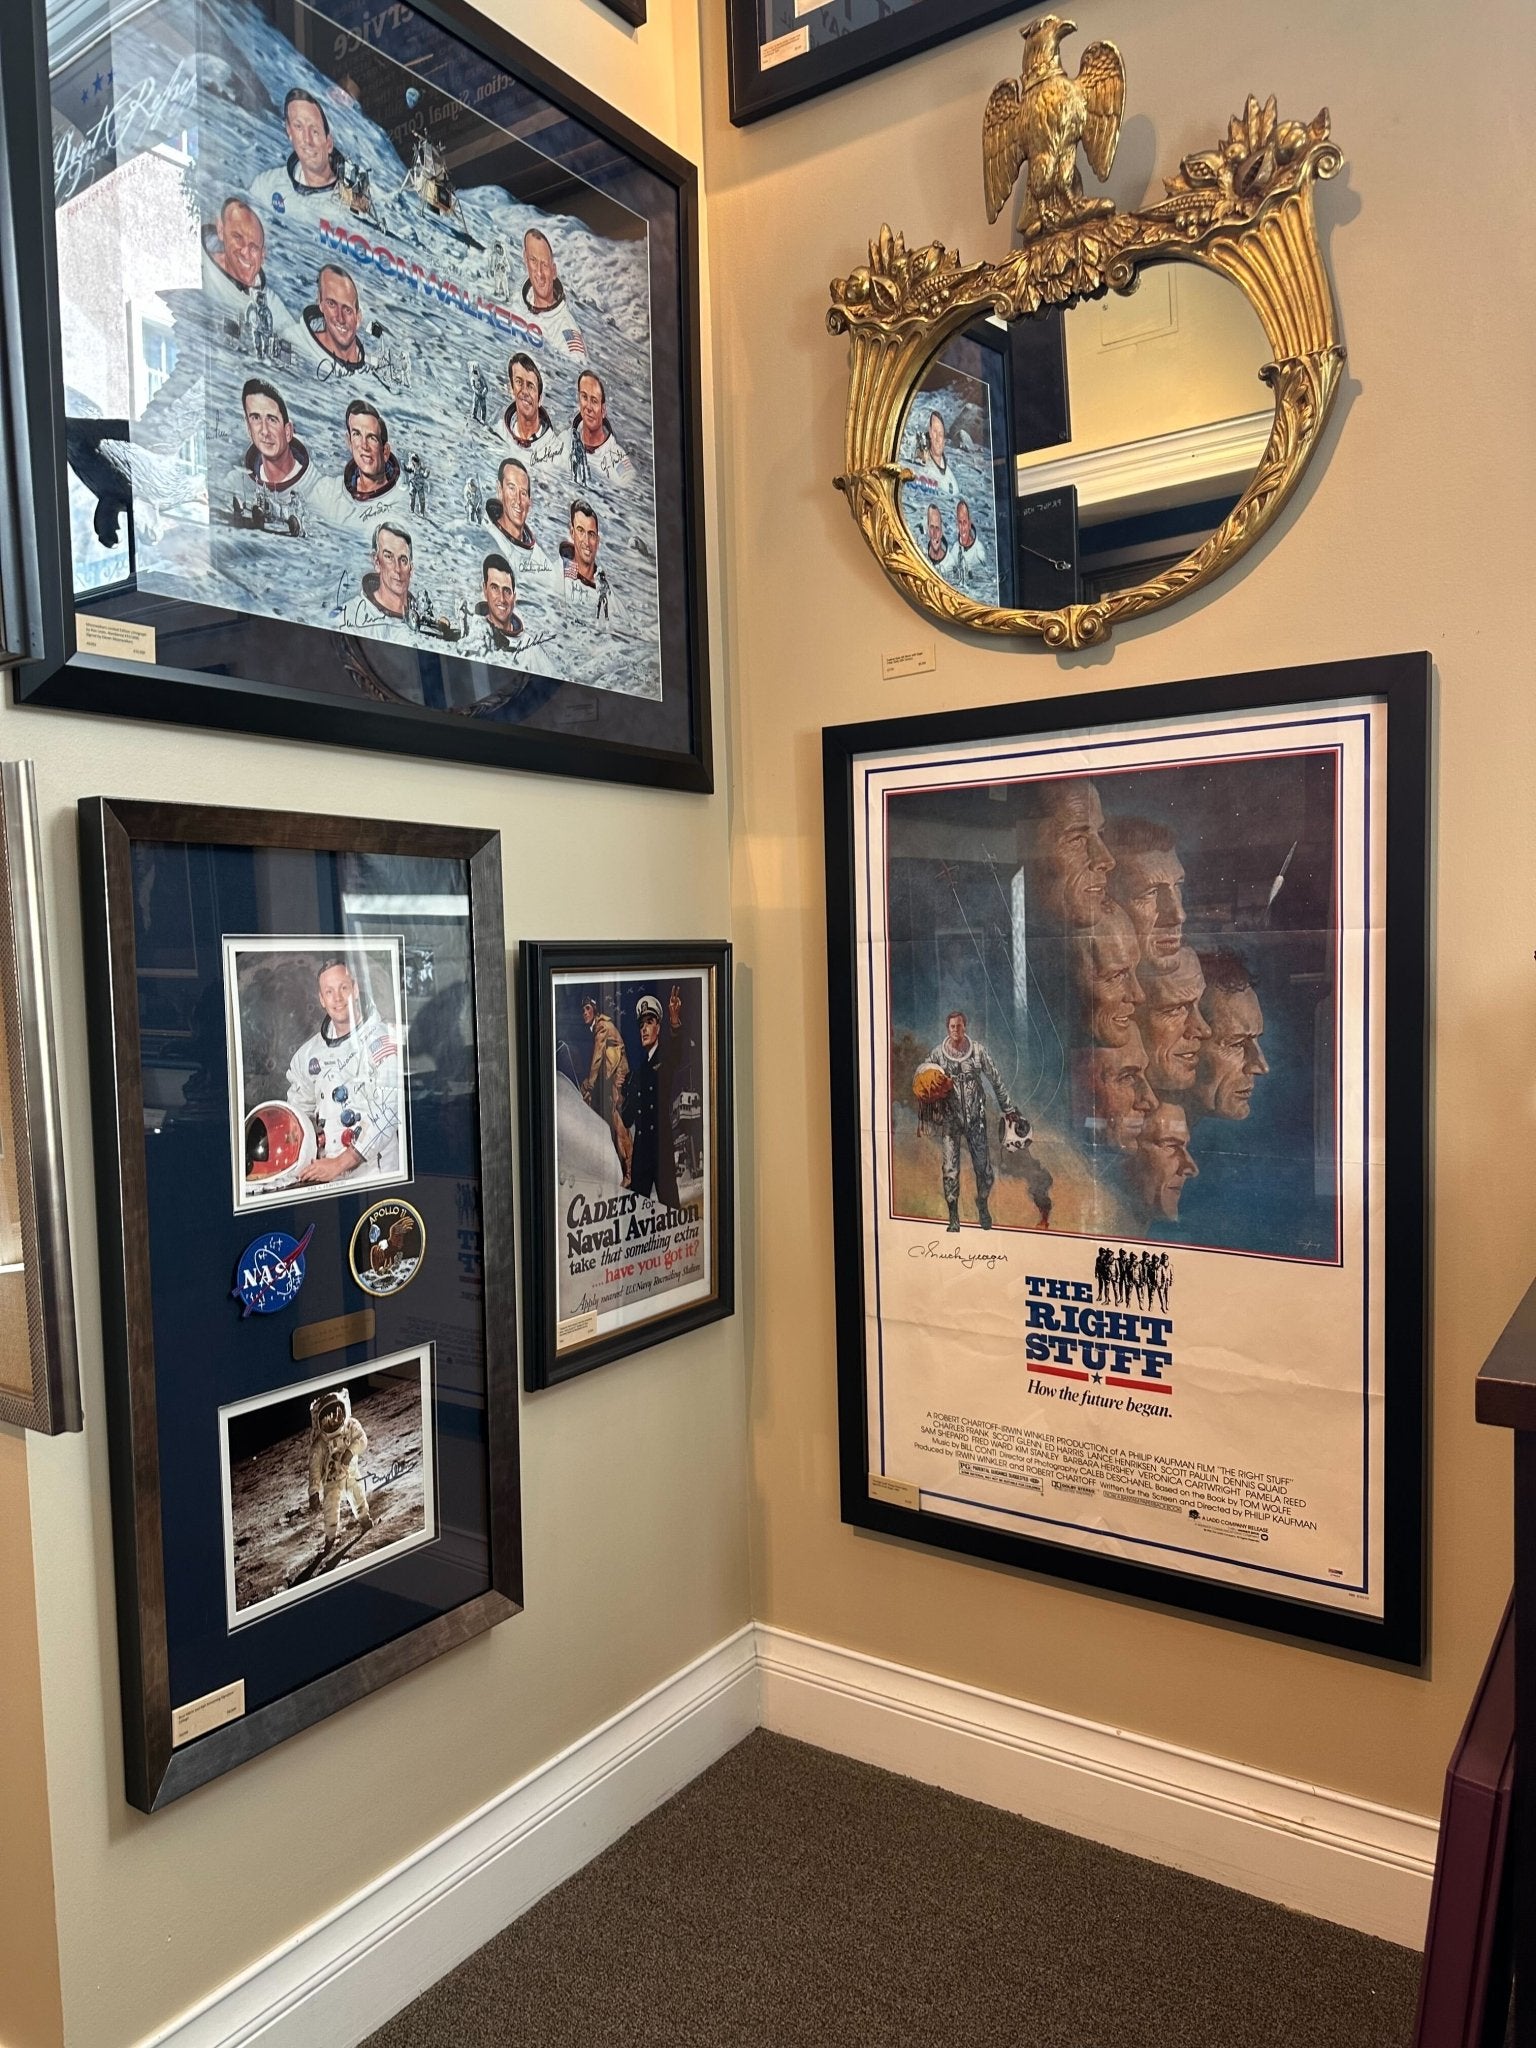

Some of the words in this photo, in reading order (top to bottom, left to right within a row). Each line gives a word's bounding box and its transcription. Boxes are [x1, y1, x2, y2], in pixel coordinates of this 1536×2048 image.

[319, 218, 544, 349] MOONWALKERS
[368, 1206, 400, 1225] APOLLO
[566, 1193, 639, 1229] CADETS
[641, 1199, 656, 1210] for
[567, 1220, 621, 1259] Naval
[625, 1203, 700, 1242] Aviation
[243, 1259, 303, 1289] NASA
[569, 1257, 597, 1276] take
[600, 1246, 623, 1266] that
[624, 1232, 671, 1259] something
[674, 1226, 699, 1244] extra
[638, 1257, 661, 1275] you
[664, 1249, 683, 1271] got
[685, 1239, 699, 1259] it?
[1025, 1275, 1093, 1304] THE
[1025, 1300, 1173, 1347] RIGHT
[1025, 1332, 1173, 1379] STUFF
[1027, 1380, 1057, 1398] How
[1059, 1385, 1080, 1403] the
[1079, 1390, 1124, 1411] future
[1126, 1397, 1173, 1419] began.
[920, 1426, 936, 1435] SAM
[938, 1430, 969, 1442] SHEPARD
[972, 1436, 989, 1446] FRED
[990, 1441, 1013, 1451] WARD
[1016, 1445, 1028, 1453] KIM
[1030, 1448, 1059, 1460] STANLEY
[1063, 1455, 1099, 1468] BARBARA
[1101, 1464, 1135, 1476] HERSHEY
[1138, 1470, 1182, 1485] VERONICA
[1184, 1479, 1241, 1496] CARTWRIGHT
[1245, 1490, 1281, 1504] PAMELA
[1283, 1497, 1306, 1508] REED
[926, 1411, 933, 1419] A
[934, 1412, 960, 1423] ROBERT
[1023, 1428, 1055, 1443] WINKLER
[1057, 1436, 1108, 1454] PRODUCTION
[1128, 1451, 1152, 1461] PHILIP
[1154, 1456, 1195, 1470] KAUFMAN
[1197, 1462, 1215, 1473] FILM
[1238, 1470, 1264, 1482] RIGHT
[933, 1420, 965, 1432] CHARLES
[966, 1427, 989, 1438] FRANK
[992, 1432, 1015, 1442] SCOTT
[1017, 1437, 1042, 1449] GLENN
[1045, 1443, 1055, 1451] ED
[1057, 1446, 1084, 1457] HARRIS
[1087, 1452, 1113, 1463] LANCE
[1115, 1458, 1157, 1472] HENRIKSEN
[1160, 1466, 1187, 1477] SCOTT
[1189, 1471, 1219, 1483] PAULIN
[1223, 1476, 1255, 1489] DENNIS
[1257, 1483, 1288, 1495] QUAID
[914, 1442, 944, 1454] Produced
[945, 1449, 953, 1457] by
[955, 1450, 975, 1461] IRWIN
[977, 1455, 1007, 1467] WINKLER
[1009, 1462, 1024, 1471] and
[1026, 1465, 1054, 1477] ROBERT
[1056, 1472, 1096, 1485] CHARTOFF
[1100, 1481, 1124, 1492] Written
[1126, 1487, 1135, 1495] for
[1138, 1489, 1149, 1498] the
[1152, 1492, 1177, 1504] Screen
[1179, 1499, 1195, 1507] and
[1197, 1502, 1230, 1514] Directed
[1233, 1509, 1242, 1517] by
[1245, 1510, 1270, 1521] PHILIP
[1273, 1515, 1317, 1530] KAUFMAN
[932, 1437, 950, 1447] Music
[975, 1446, 996, 1456] CONTI
[1000, 1451, 1024, 1462] Director
[1034, 1458, 1078, 1474] Photography
[1080, 1467, 1105, 1479] CALEB
[1106, 1472, 1153, 1489] DESCHANEL
[1155, 1484, 1178, 1494] Based
[1192, 1491, 1205, 1500] the
[1207, 1494, 1226, 1503] Book
[1228, 1498, 1238, 1506] by
[1240, 1499, 1260, 1510] TOM
[1262, 1502, 1291, 1515] WOLFE
